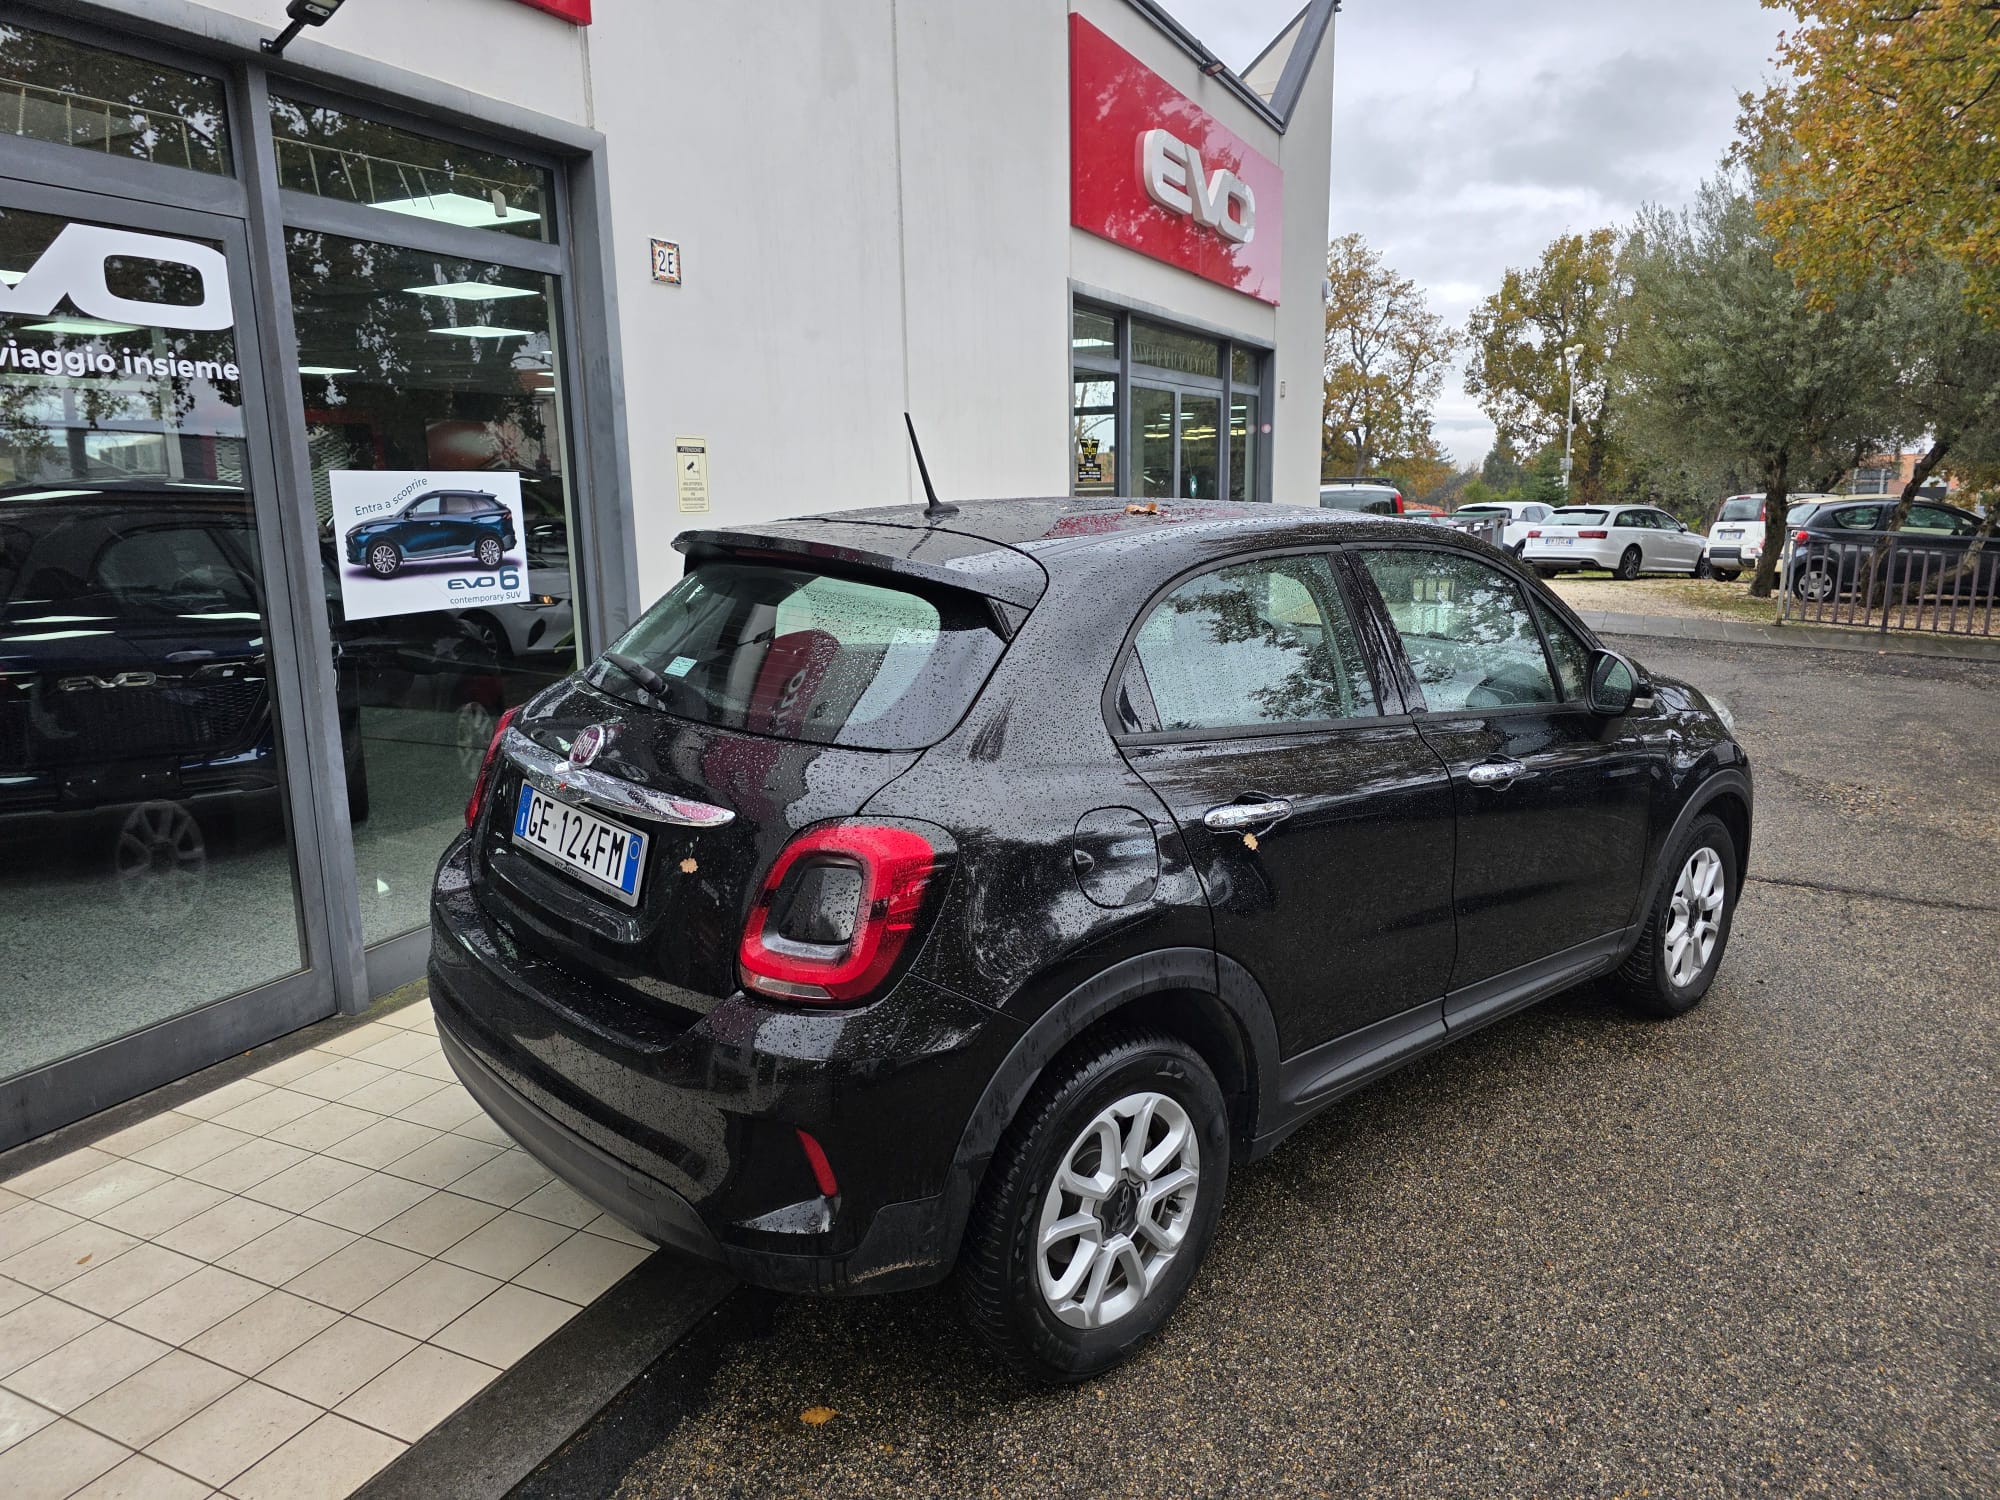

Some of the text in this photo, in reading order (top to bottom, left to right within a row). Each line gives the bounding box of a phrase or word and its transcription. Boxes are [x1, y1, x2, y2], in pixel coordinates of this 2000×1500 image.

[1143, 129, 1255, 243] EVO
[657, 250, 674, 274] 2E
[123, 348, 239, 381] insieme
[355, 502, 383, 516] Entra
[393, 477, 428, 504] scoprire
[450, 591, 521, 605] contemporary SUV
